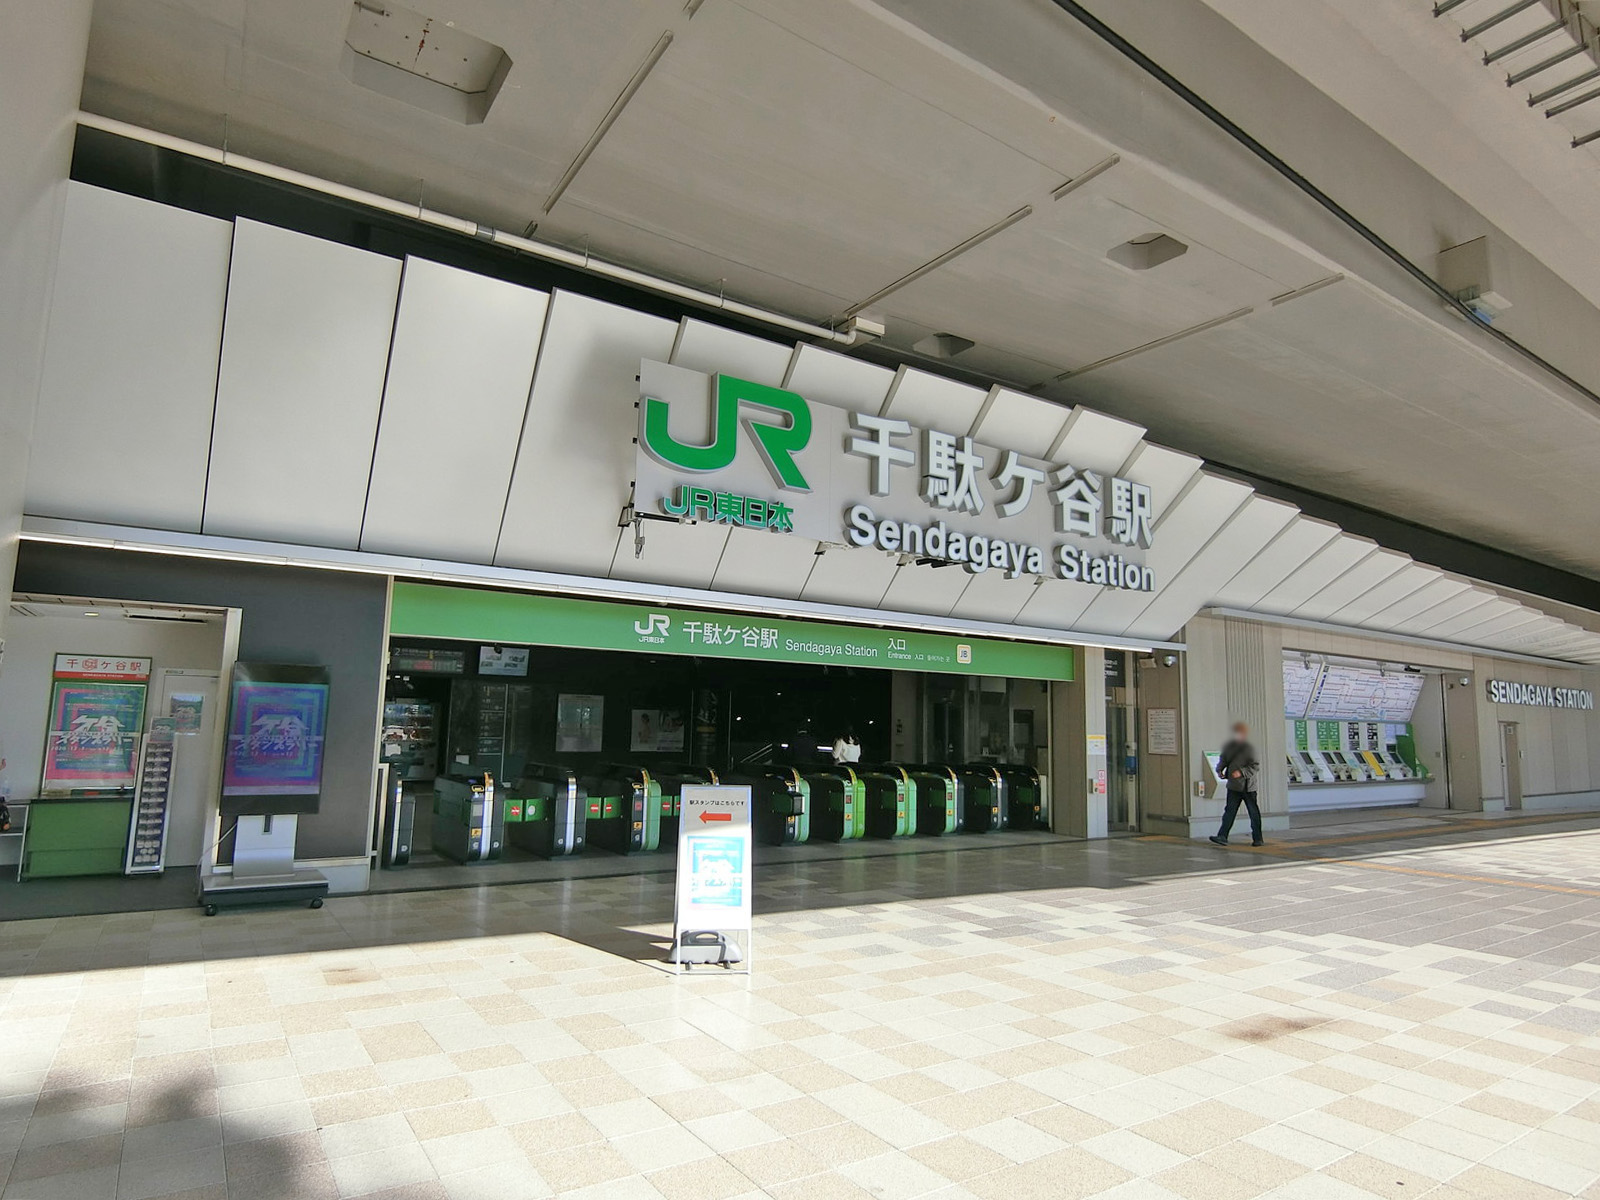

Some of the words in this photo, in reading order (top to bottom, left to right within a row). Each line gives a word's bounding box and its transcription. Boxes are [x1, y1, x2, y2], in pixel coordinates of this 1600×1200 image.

[641, 372, 813, 493] JR
[846, 412, 1153, 549] 千駄ケ谷駅
[660, 485, 794, 533] JR東日本
[845, 505, 1044, 579] Sendagaya
[1054, 544, 1155, 592] Station
[634, 613, 671, 636] JR
[682, 621, 778, 649] 千駄ケ谷駅
[785, 639, 842, 660] Sendagaya
[845, 645, 878, 657] Station
[887, 638, 906, 651] 入口
[887, 651, 912, 660] Entrance
[1490, 679, 1554, 707] SENDAGAYA
[1555, 687, 1593, 710] STATION
